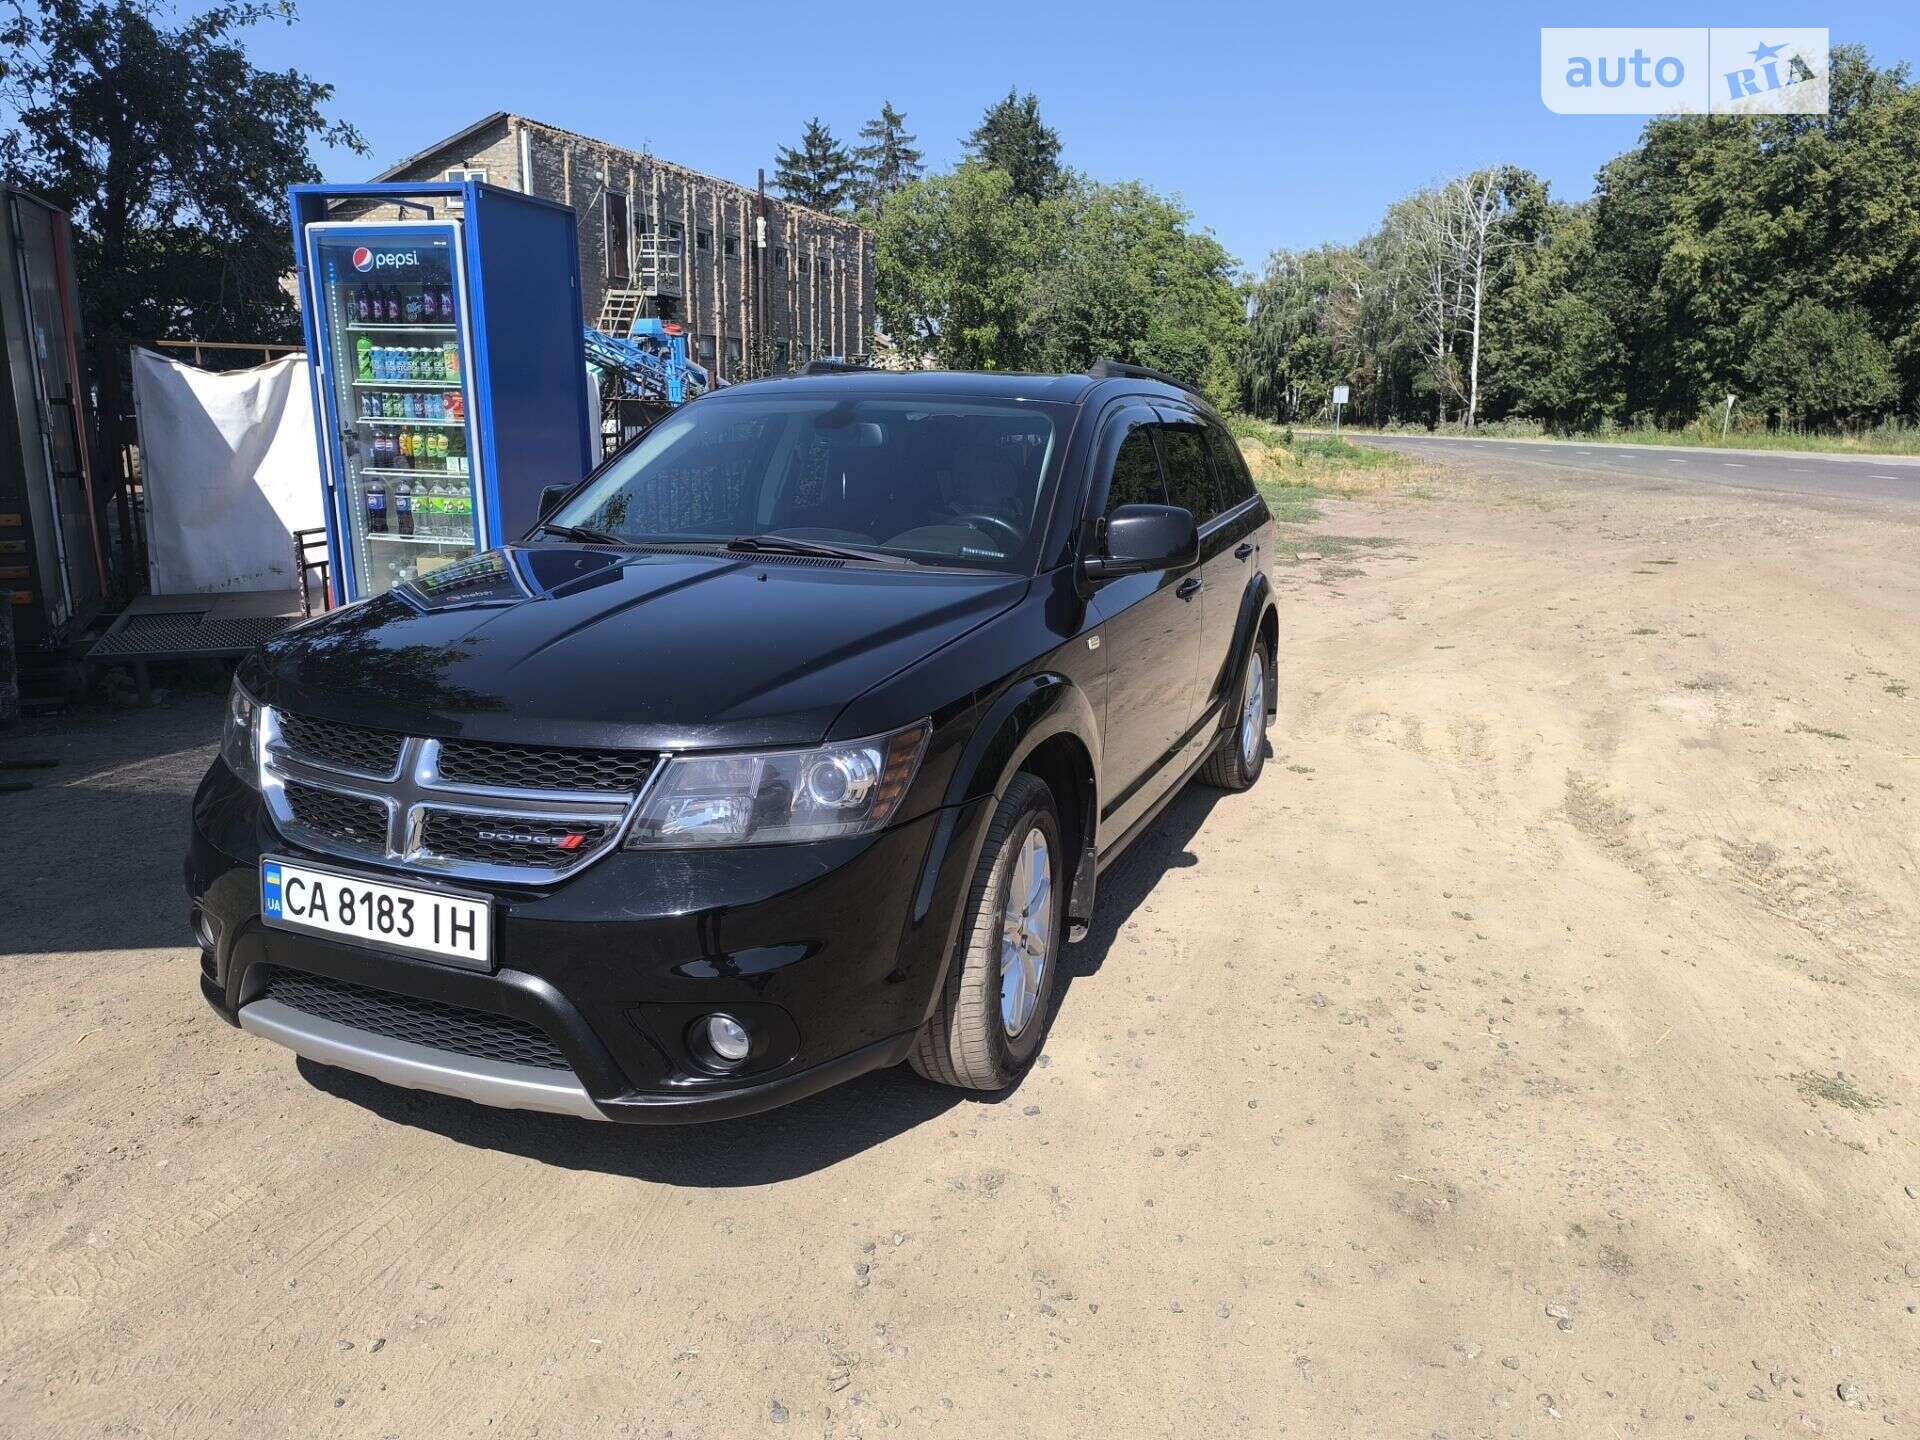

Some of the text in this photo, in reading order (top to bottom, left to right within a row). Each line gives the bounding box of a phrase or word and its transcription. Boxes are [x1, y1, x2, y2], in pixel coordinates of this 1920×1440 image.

[375, 250, 419, 269] pepsi
[479, 831, 566, 845] DODGE
[267, 898, 280, 912] UA
[285, 877, 476, 951] CA 8183 IH
